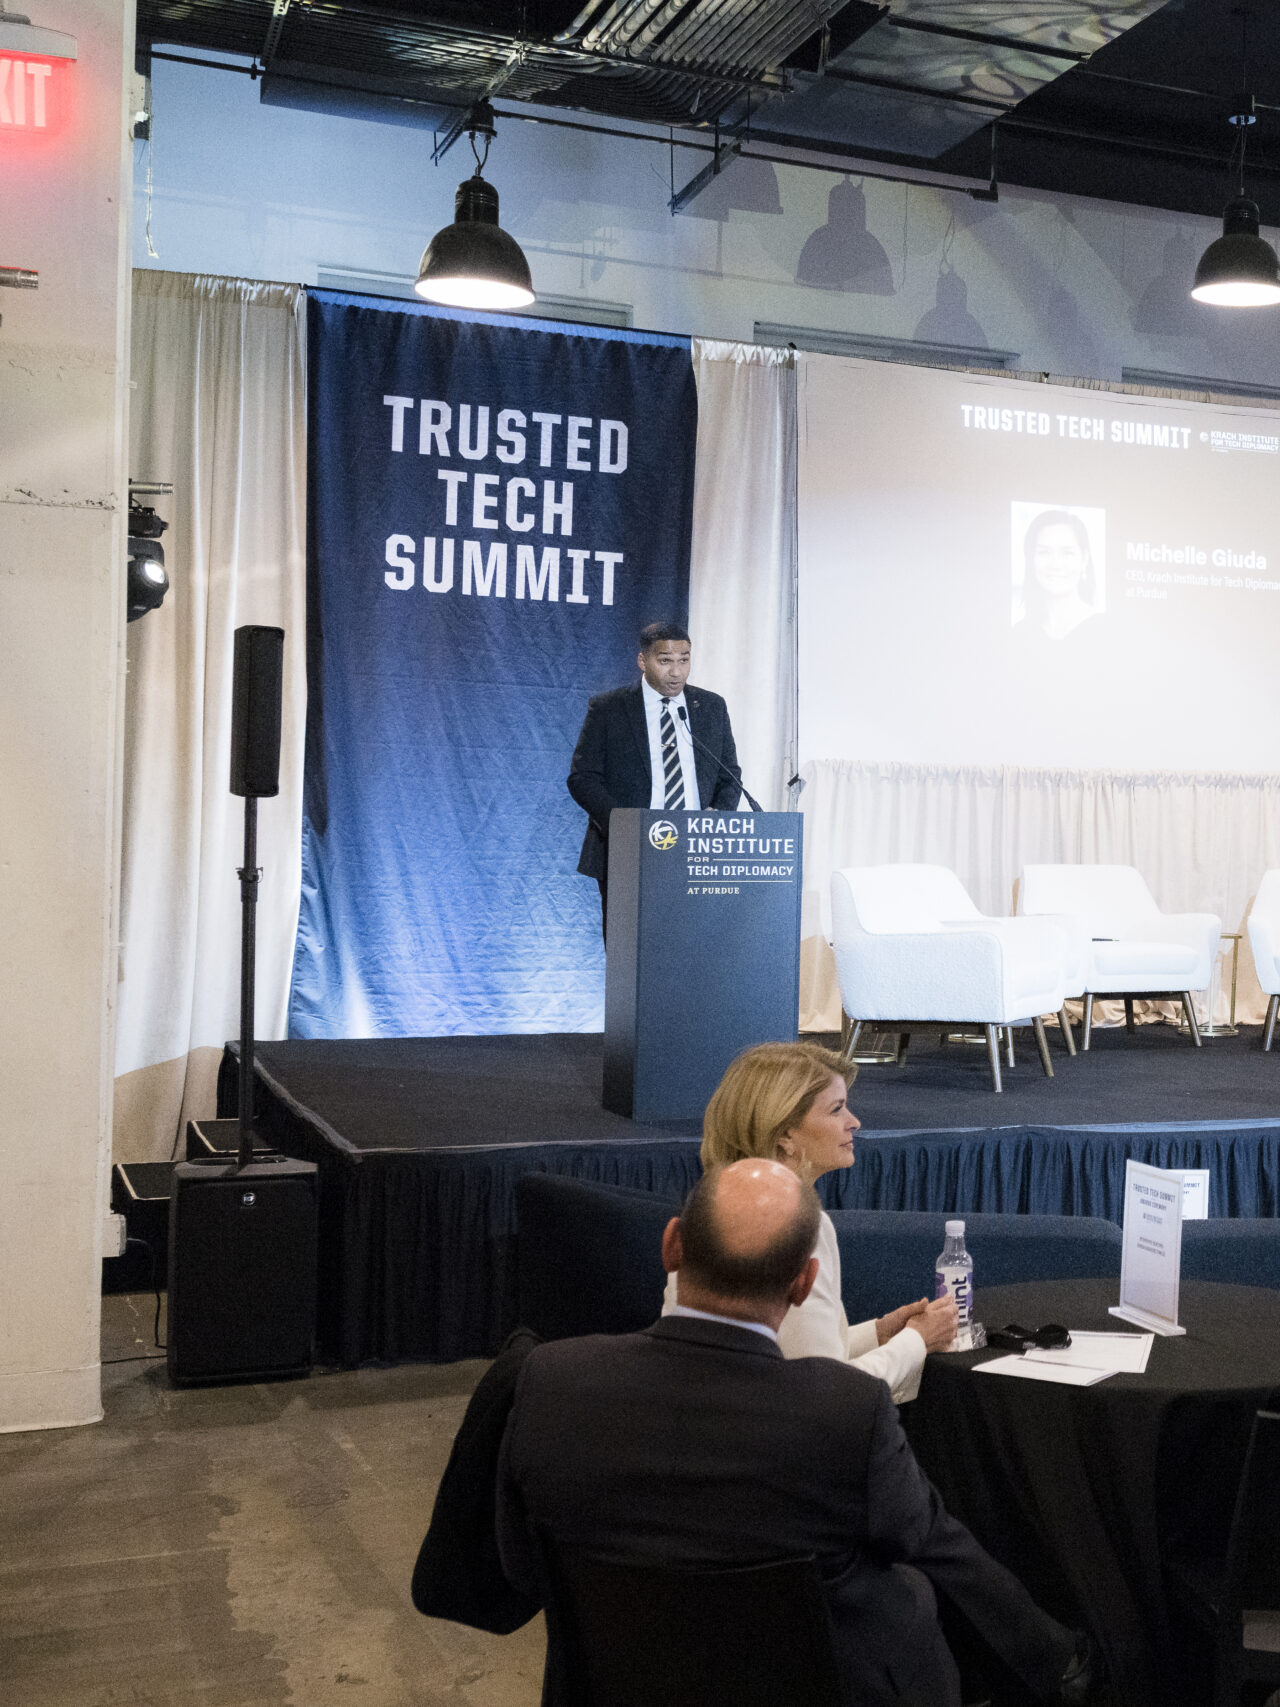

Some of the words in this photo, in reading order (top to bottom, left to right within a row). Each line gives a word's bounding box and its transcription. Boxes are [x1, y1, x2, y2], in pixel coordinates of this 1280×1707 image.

[383, 394, 629, 474] TRUSTED
[961, 404, 1050, 435] TRUSTED
[1056, 414, 1105, 441] TECH
[1111, 419, 1192, 449] SUMMIT
[1210, 430, 1237, 441] KRACH
[1238, 433, 1279, 445] INSTITUTE
[1210, 438, 1224, 446] FOR
[1225, 439, 1241, 448] TECH
[1242, 440, 1279, 451] DIPLOMACY
[437, 468, 574, 536] TECH
[1125, 542, 1208, 565] Michelle
[1211, 548, 1268, 570] Giuda
[384, 533, 624, 606] SUMMIT
[1147, 571, 1172, 584] Krach
[1174, 573, 1209, 586] Institute
[1210, 574, 1222, 587] for
[1223, 575, 1243, 588] Tech
[1136, 587, 1168, 600] Purdue
[687, 817, 755, 835] KRACH
[687, 838, 794, 854] INSTITUTE
[687, 865, 718, 876] TECH
[722, 865, 794, 876] DIPLOMACY
[687, 887, 700, 895] AT
[702, 887, 740, 895] PURDUE
